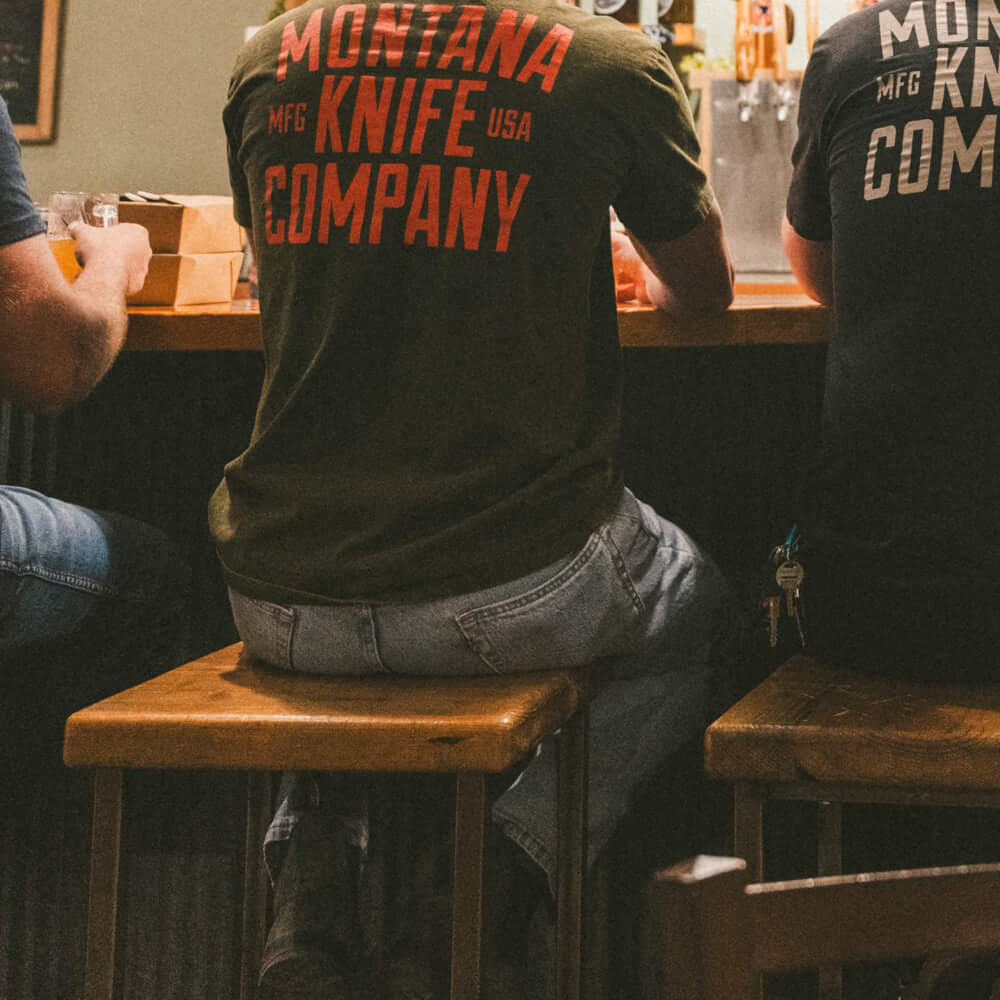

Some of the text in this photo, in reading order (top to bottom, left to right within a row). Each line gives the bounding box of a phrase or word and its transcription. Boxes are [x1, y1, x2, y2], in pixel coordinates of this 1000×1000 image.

[276, 3, 575, 93] MONTANA
[876, 70, 921, 104] MFG
[268, 75, 532, 158] MFG KNIFE USA
[264, 162, 532, 253] COMPANY
